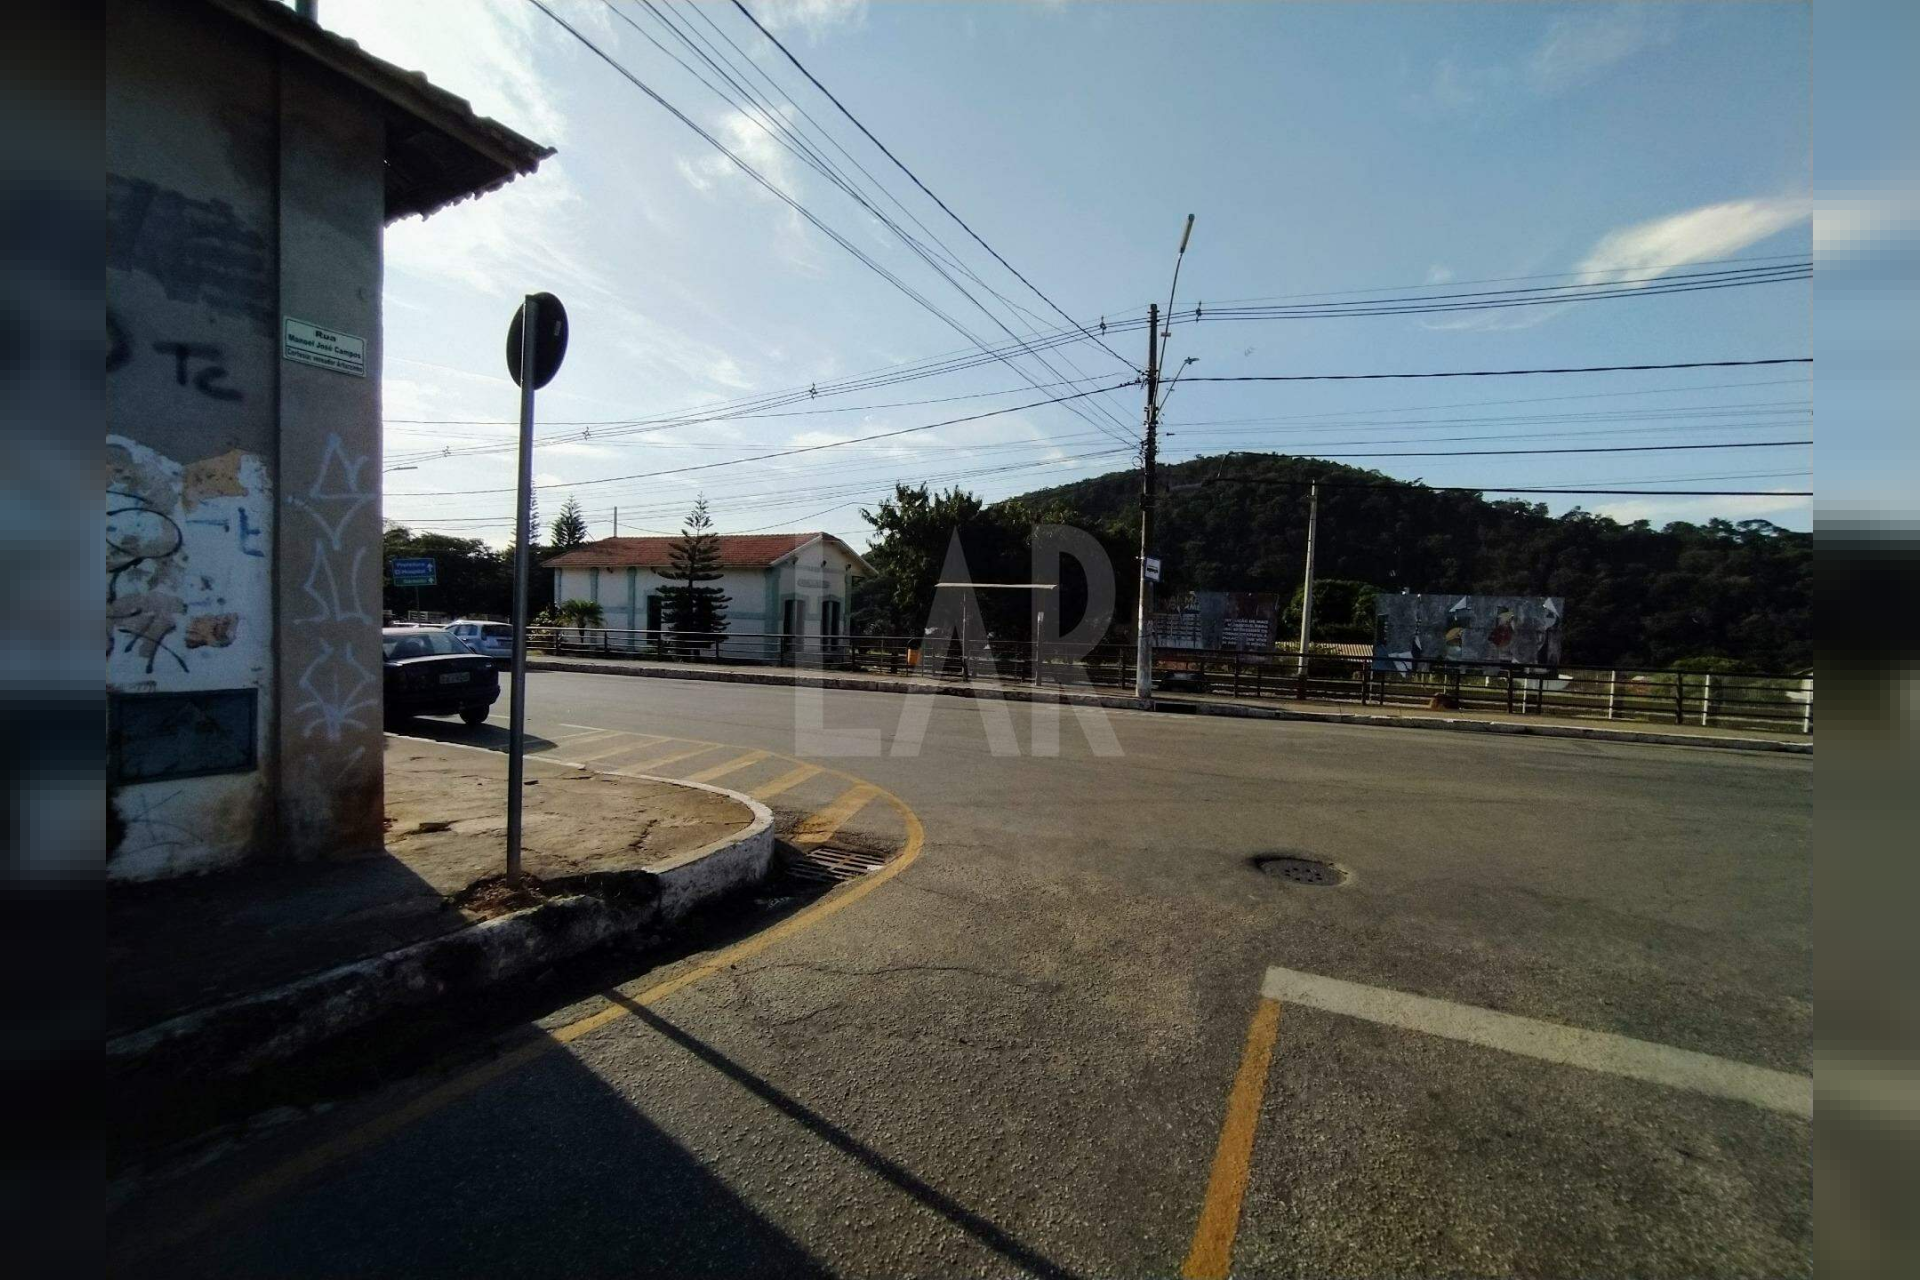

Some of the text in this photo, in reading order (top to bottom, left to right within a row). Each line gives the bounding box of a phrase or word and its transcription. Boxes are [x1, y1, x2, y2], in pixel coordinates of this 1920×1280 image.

[315, 330, 336, 342] Rua
[316, 342, 332, 351] José
[334, 346, 361, 359] Campos
